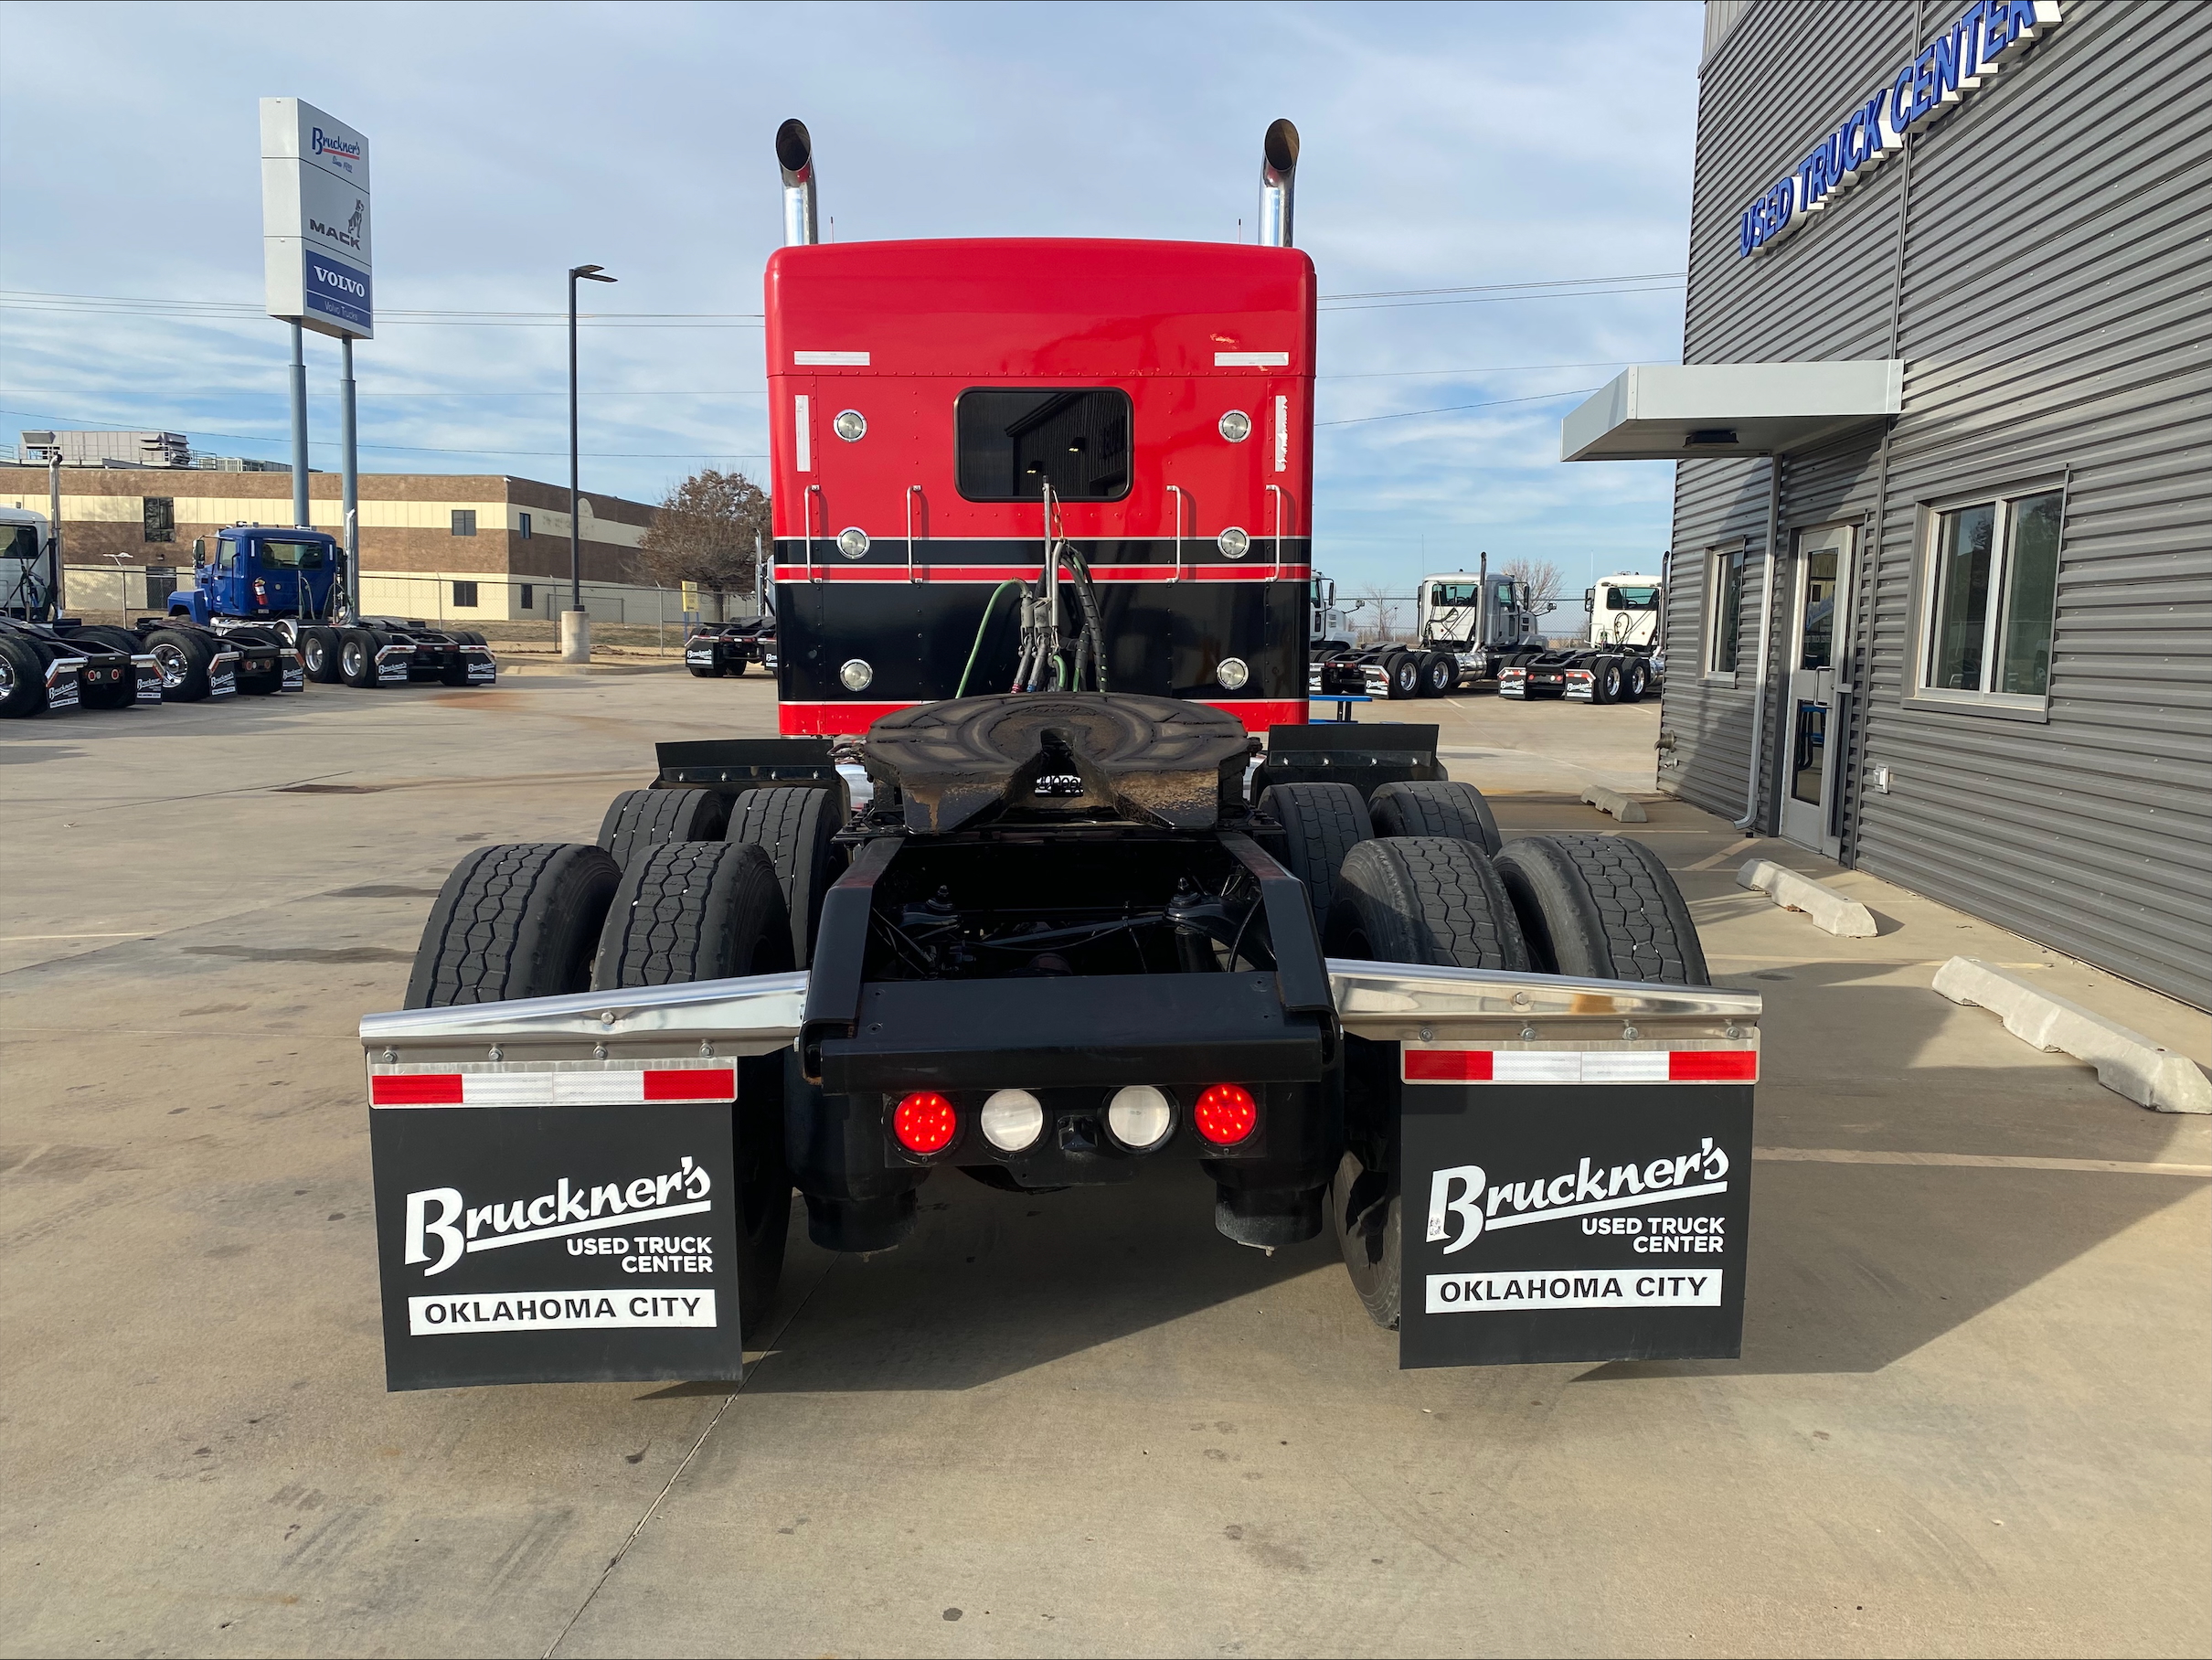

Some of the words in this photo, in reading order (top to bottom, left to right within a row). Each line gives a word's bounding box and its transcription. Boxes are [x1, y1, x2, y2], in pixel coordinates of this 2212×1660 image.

[312, 126, 360, 156] Bruckner's
[1740, 176, 1794, 259] USED
[1798, 89, 1888, 212] TRUCK
[309, 218, 361, 251] MACK
[314, 265, 365, 298] VOLVO
[1426, 1137, 1729, 1254] Bruckner's
[405, 1156, 711, 1277] Bruckner's
[1581, 1218, 1643, 1236] USED
[1646, 1217, 1726, 1235] TRUCK
[567, 1237, 630, 1256] USED
[633, 1236, 713, 1255] TRUCK
[1632, 1236, 1724, 1253] CENTER
[622, 1255, 713, 1273] CENTER
[1440, 1277, 1623, 1303] OKLAHOMA
[1635, 1276, 1707, 1298] CITY
[424, 1297, 617, 1325] OKLAHOMA
[629, 1296, 701, 1318] CITY
